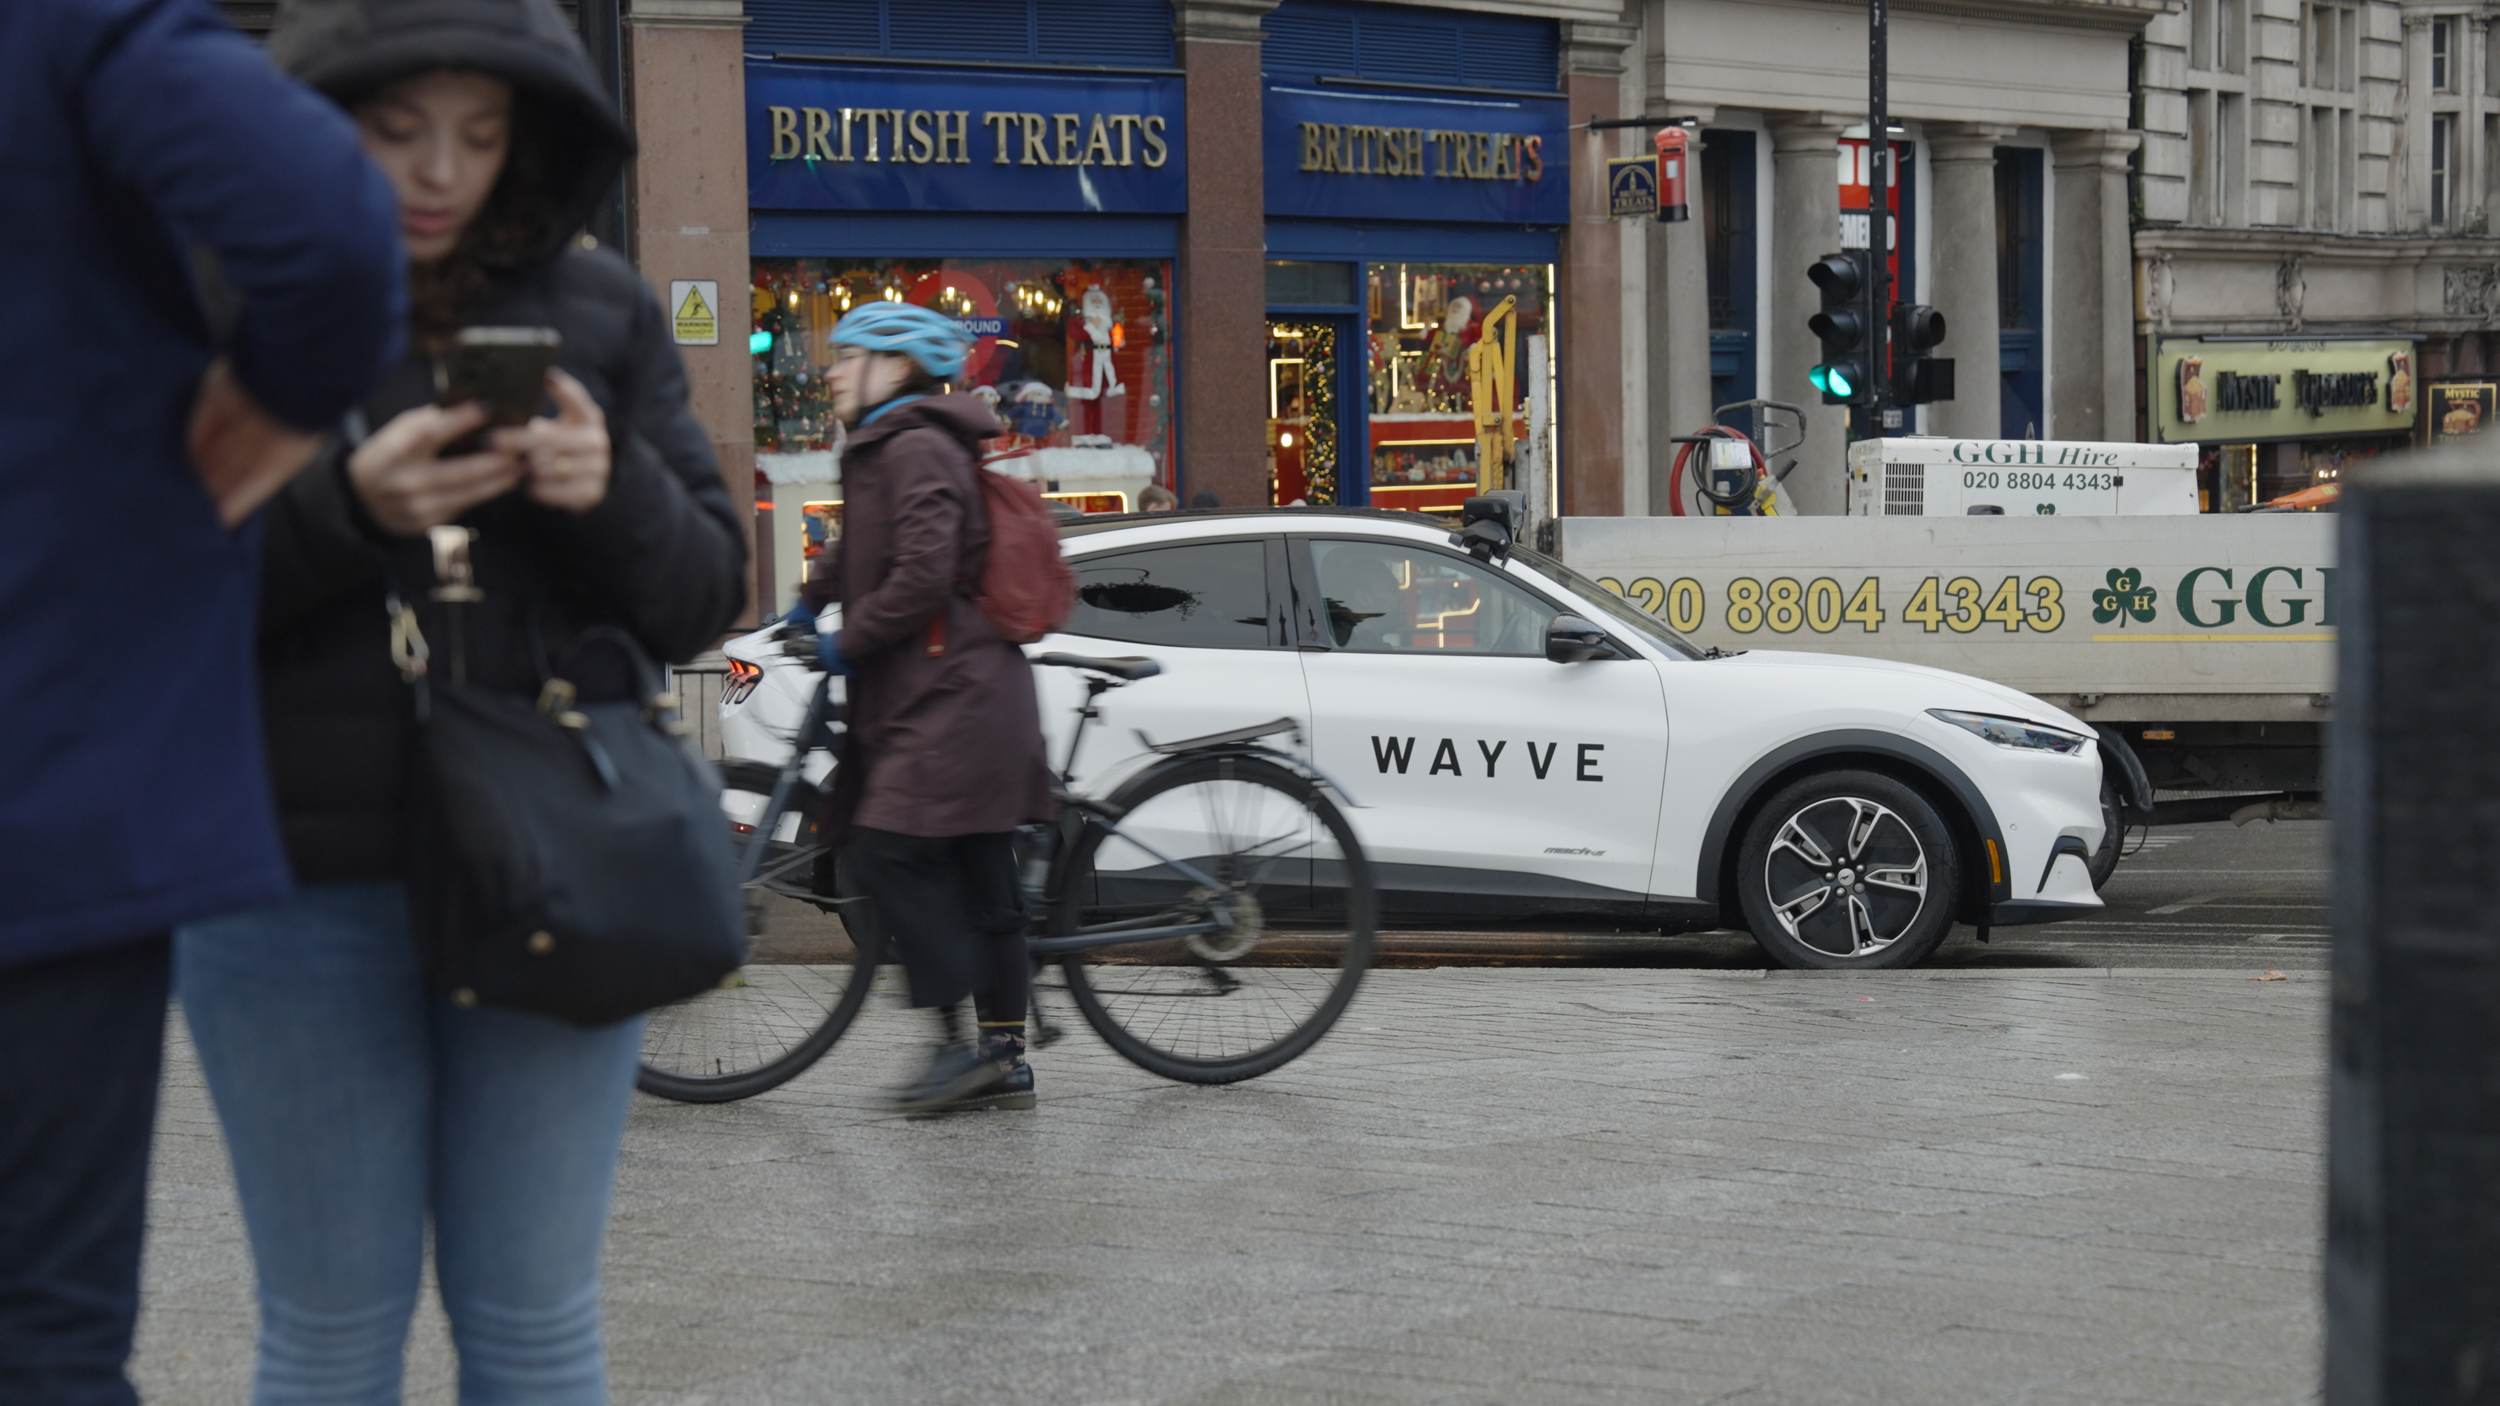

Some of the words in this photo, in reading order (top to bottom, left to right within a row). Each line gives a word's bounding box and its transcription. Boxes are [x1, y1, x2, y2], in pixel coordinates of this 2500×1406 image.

[768, 105, 971, 164] BRITISH
[982, 110, 1169, 168] TREATS
[1298, 121, 1425, 177] BRITISH
[1427, 128, 1543, 182] TREATS
[1613, 196, 1655, 208] TREATS
[2445, 388, 2480, 400] MYSTIC
[1952, 441, 2047, 465] GGH
[2058, 447, 2119, 467] Hire
[1963, 471, 1999, 489] 020
[2006, 472, 2056, 490] 8804
[2062, 473, 2112, 491] 4343
[1725, 576, 1886, 634] 8804
[1902, 575, 2066, 634] 4343
[1371, 735, 1605, 783] WAYVE
